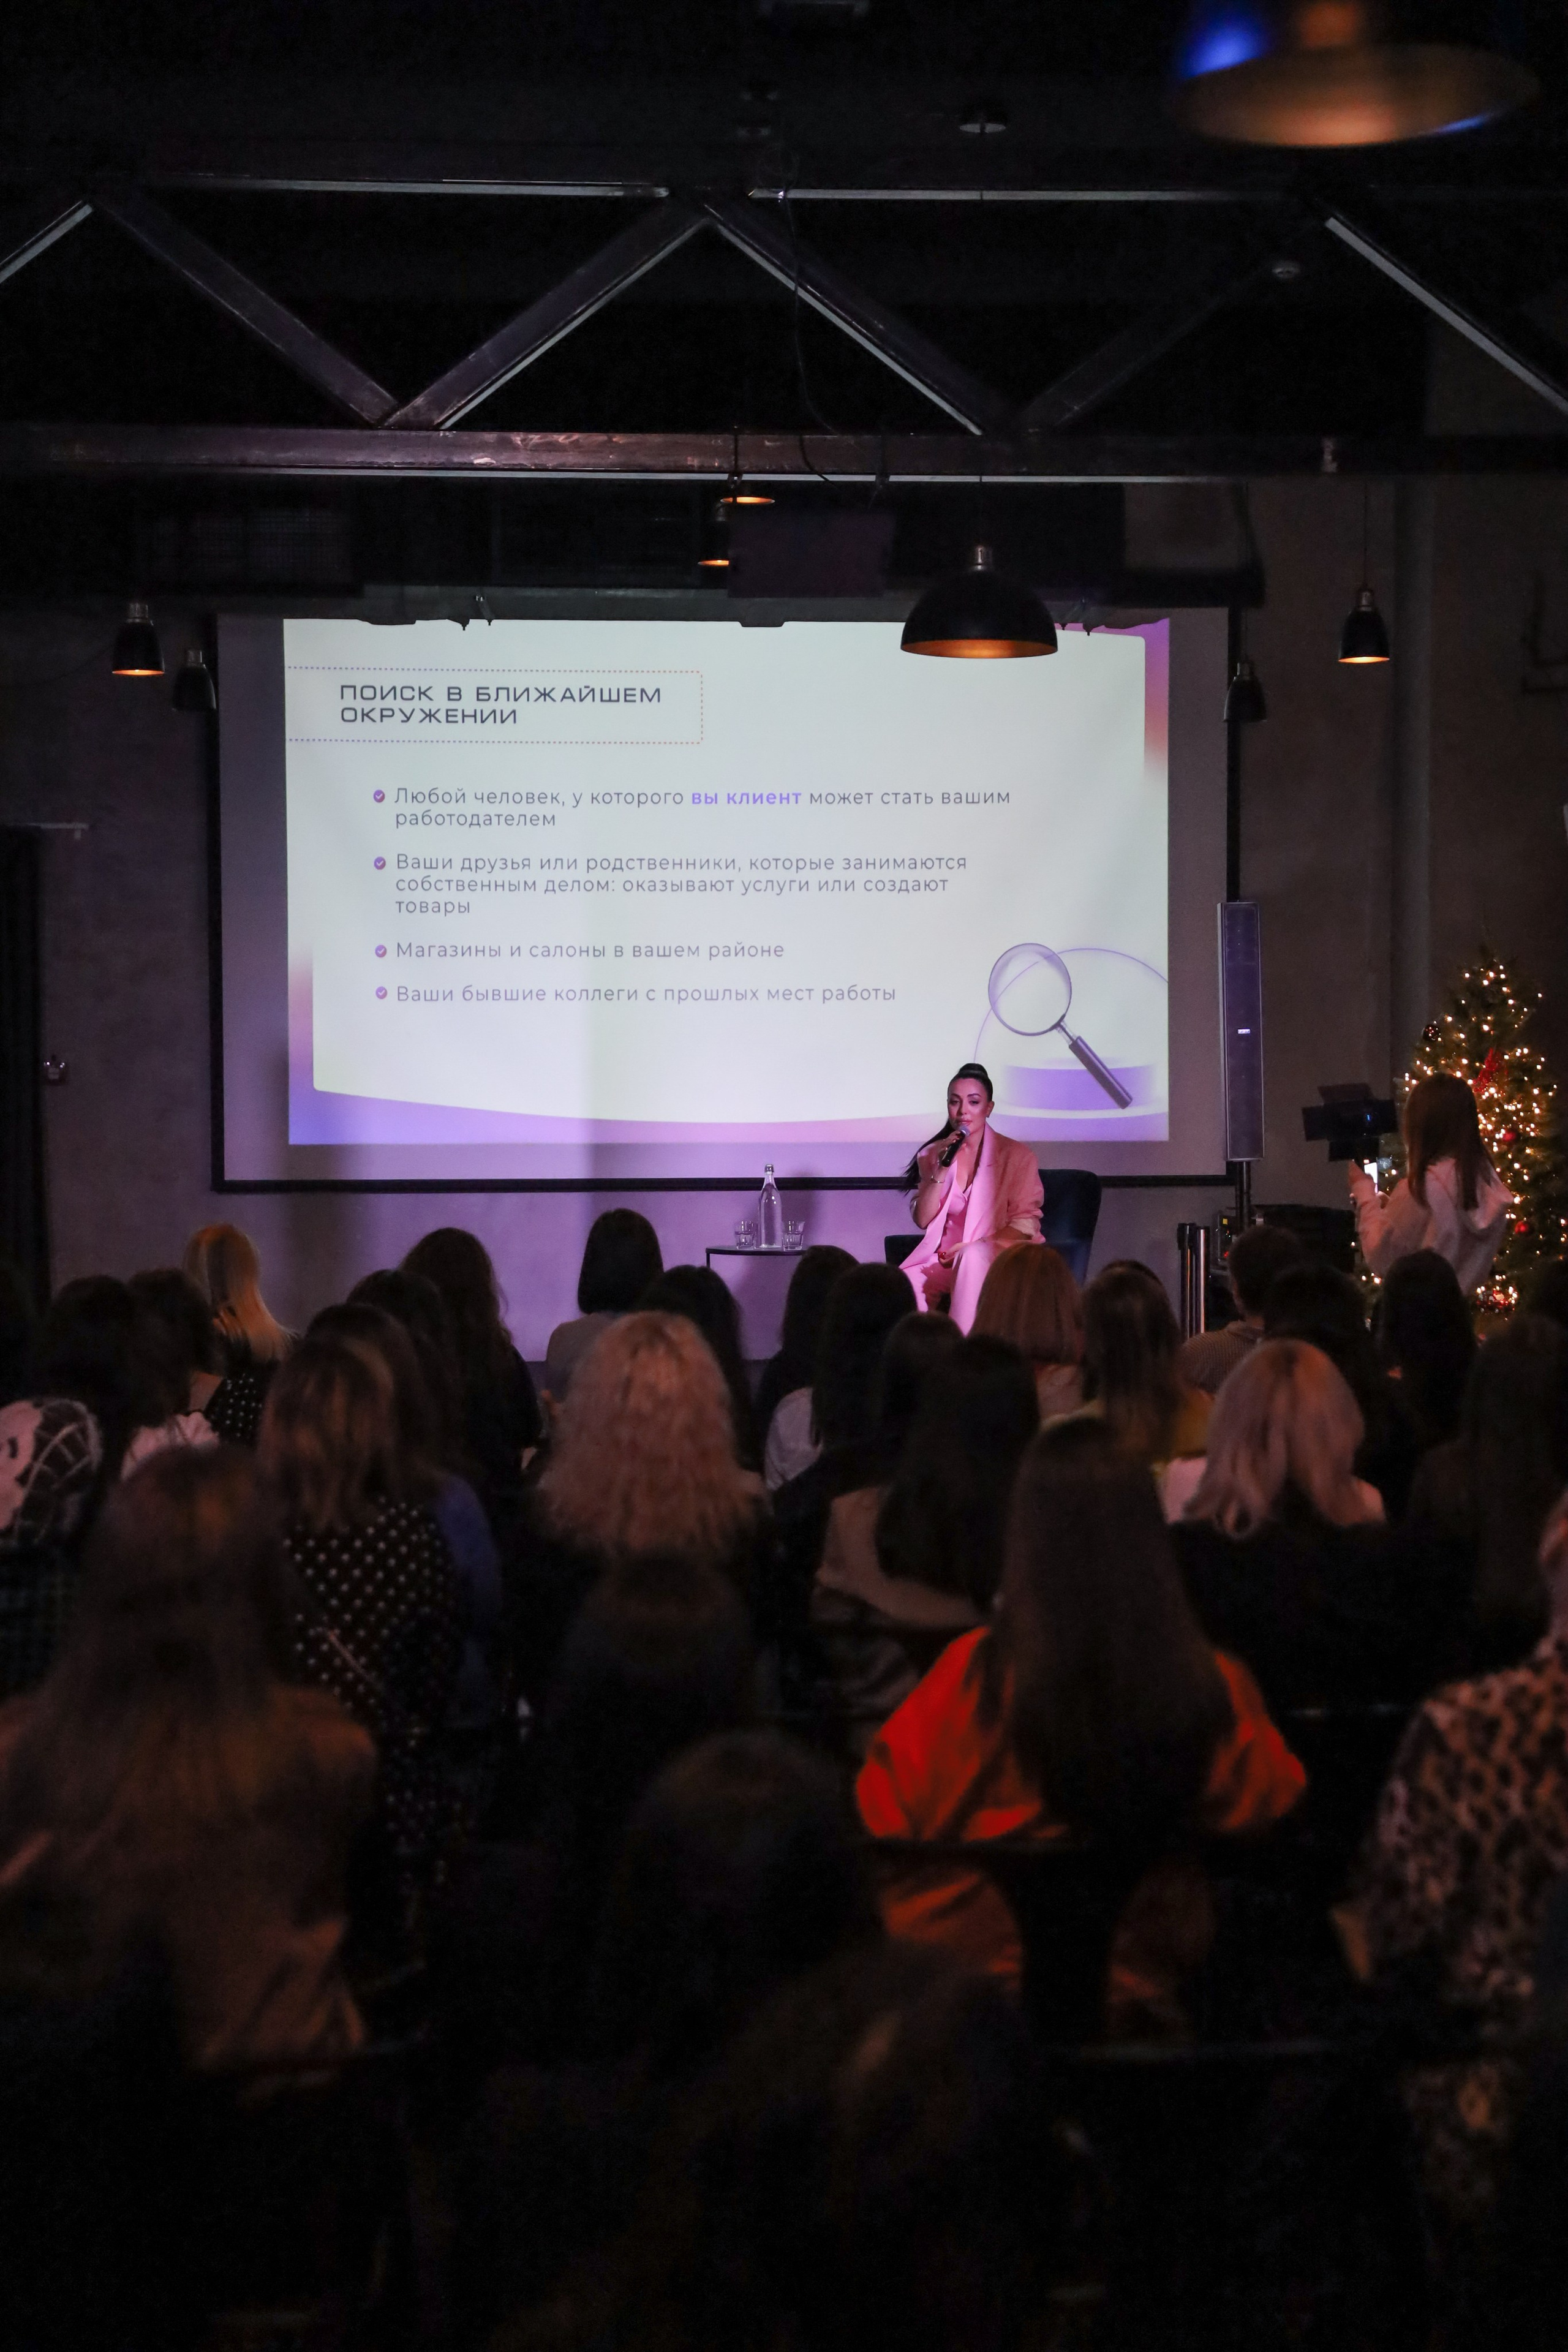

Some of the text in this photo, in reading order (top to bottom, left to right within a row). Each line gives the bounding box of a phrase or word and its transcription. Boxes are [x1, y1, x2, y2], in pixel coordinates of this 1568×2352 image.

[341, 685, 660, 703] ПОИСК В БЛИЖАЙШЕМ
[341, 707, 516, 724] ОКРУЖЕНИИ
[394, 787, 1009, 808] Любой человек, у которого вы клиент может стать вашим
[396, 809, 555, 829] работодателем
[398, 854, 966, 873] Ваши друзья или родственники, которые занимаются
[396, 875, 948, 895] собственным делом: оказывают услуги или создают
[396, 901, 469, 917] товары
[398, 942, 784, 961] Магазины и салоны в вашем районе
[398, 984, 895, 1005] Ваши бывшие коллеги с прошлых мест работы
